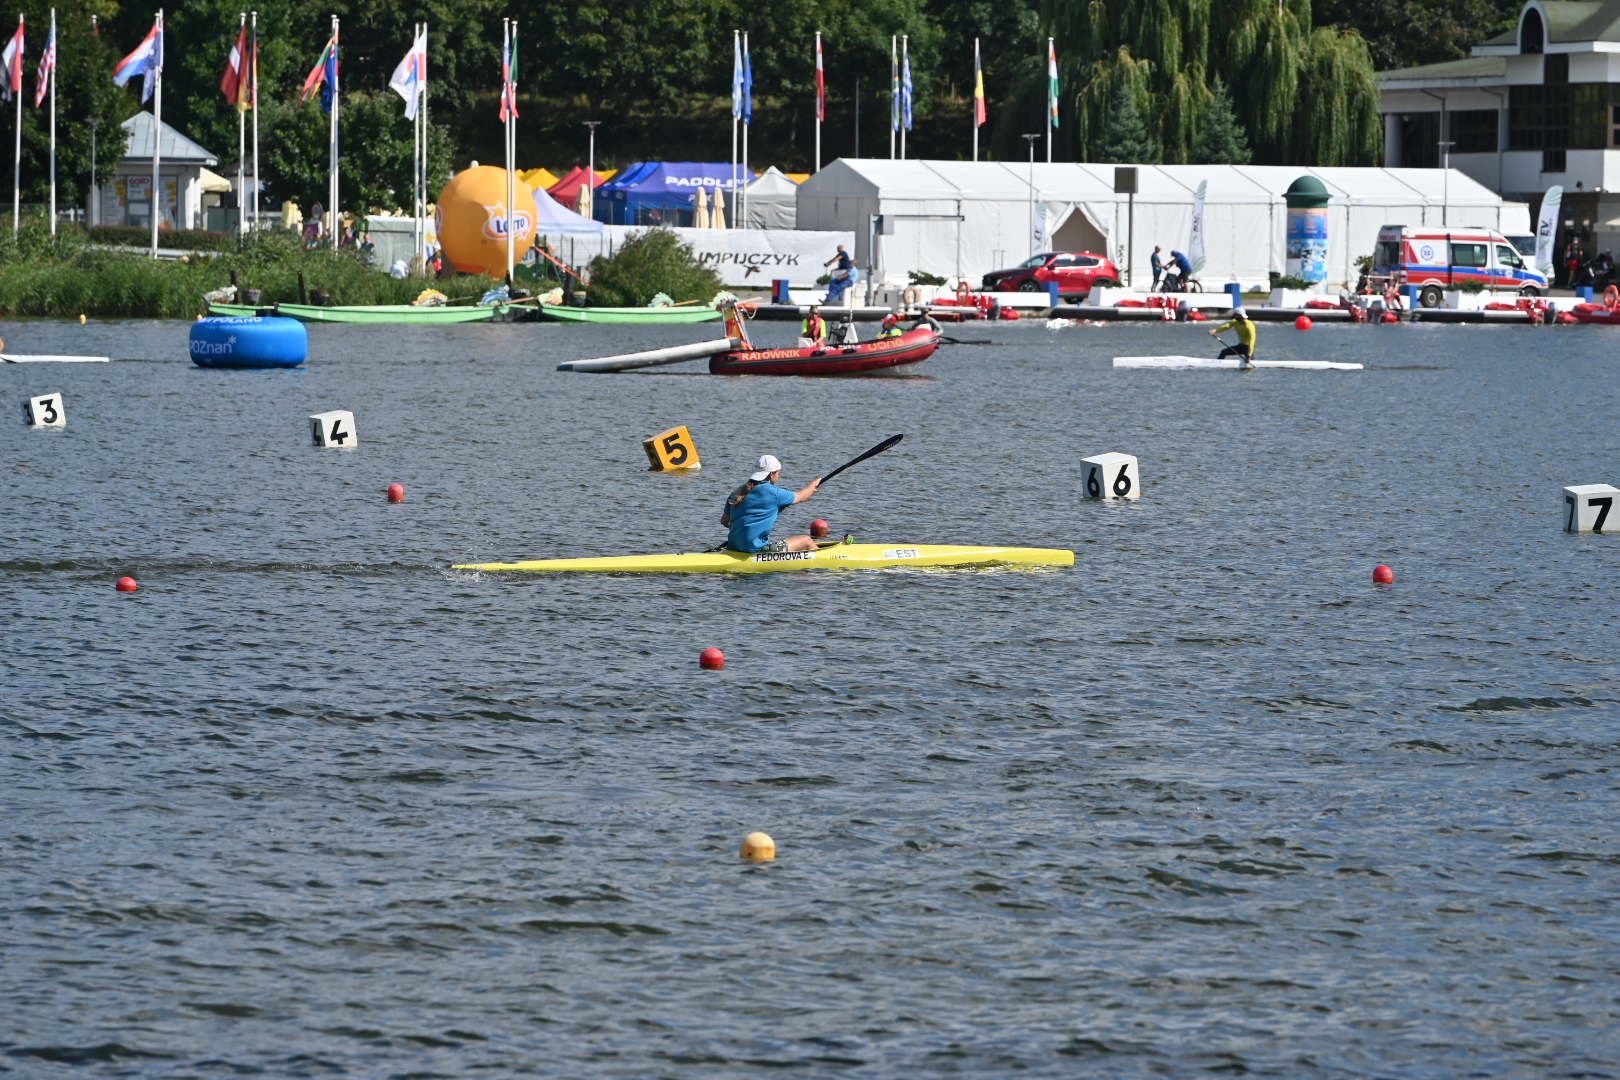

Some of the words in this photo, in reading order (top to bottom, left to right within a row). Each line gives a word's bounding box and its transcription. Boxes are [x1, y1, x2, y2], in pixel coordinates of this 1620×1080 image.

[665, 176, 737, 188] PADDLE
[1540, 220, 1549, 236] EV
[699, 252, 800, 266] IMPIJCZYK
[741, 350, 801, 361] RATOWNIK
[39, 398, 58, 424] 3
[330, 419, 349, 445] 4
[662, 432, 688, 466] 5
[1087, 466, 1100, 497] 6
[1112, 463, 1132, 497] 6
[1565, 494, 1575, 532] 7
[1588, 496, 1613, 534] 7
[756, 552, 801, 562] FEDOROVA
[896, 549, 918, 559] EST
